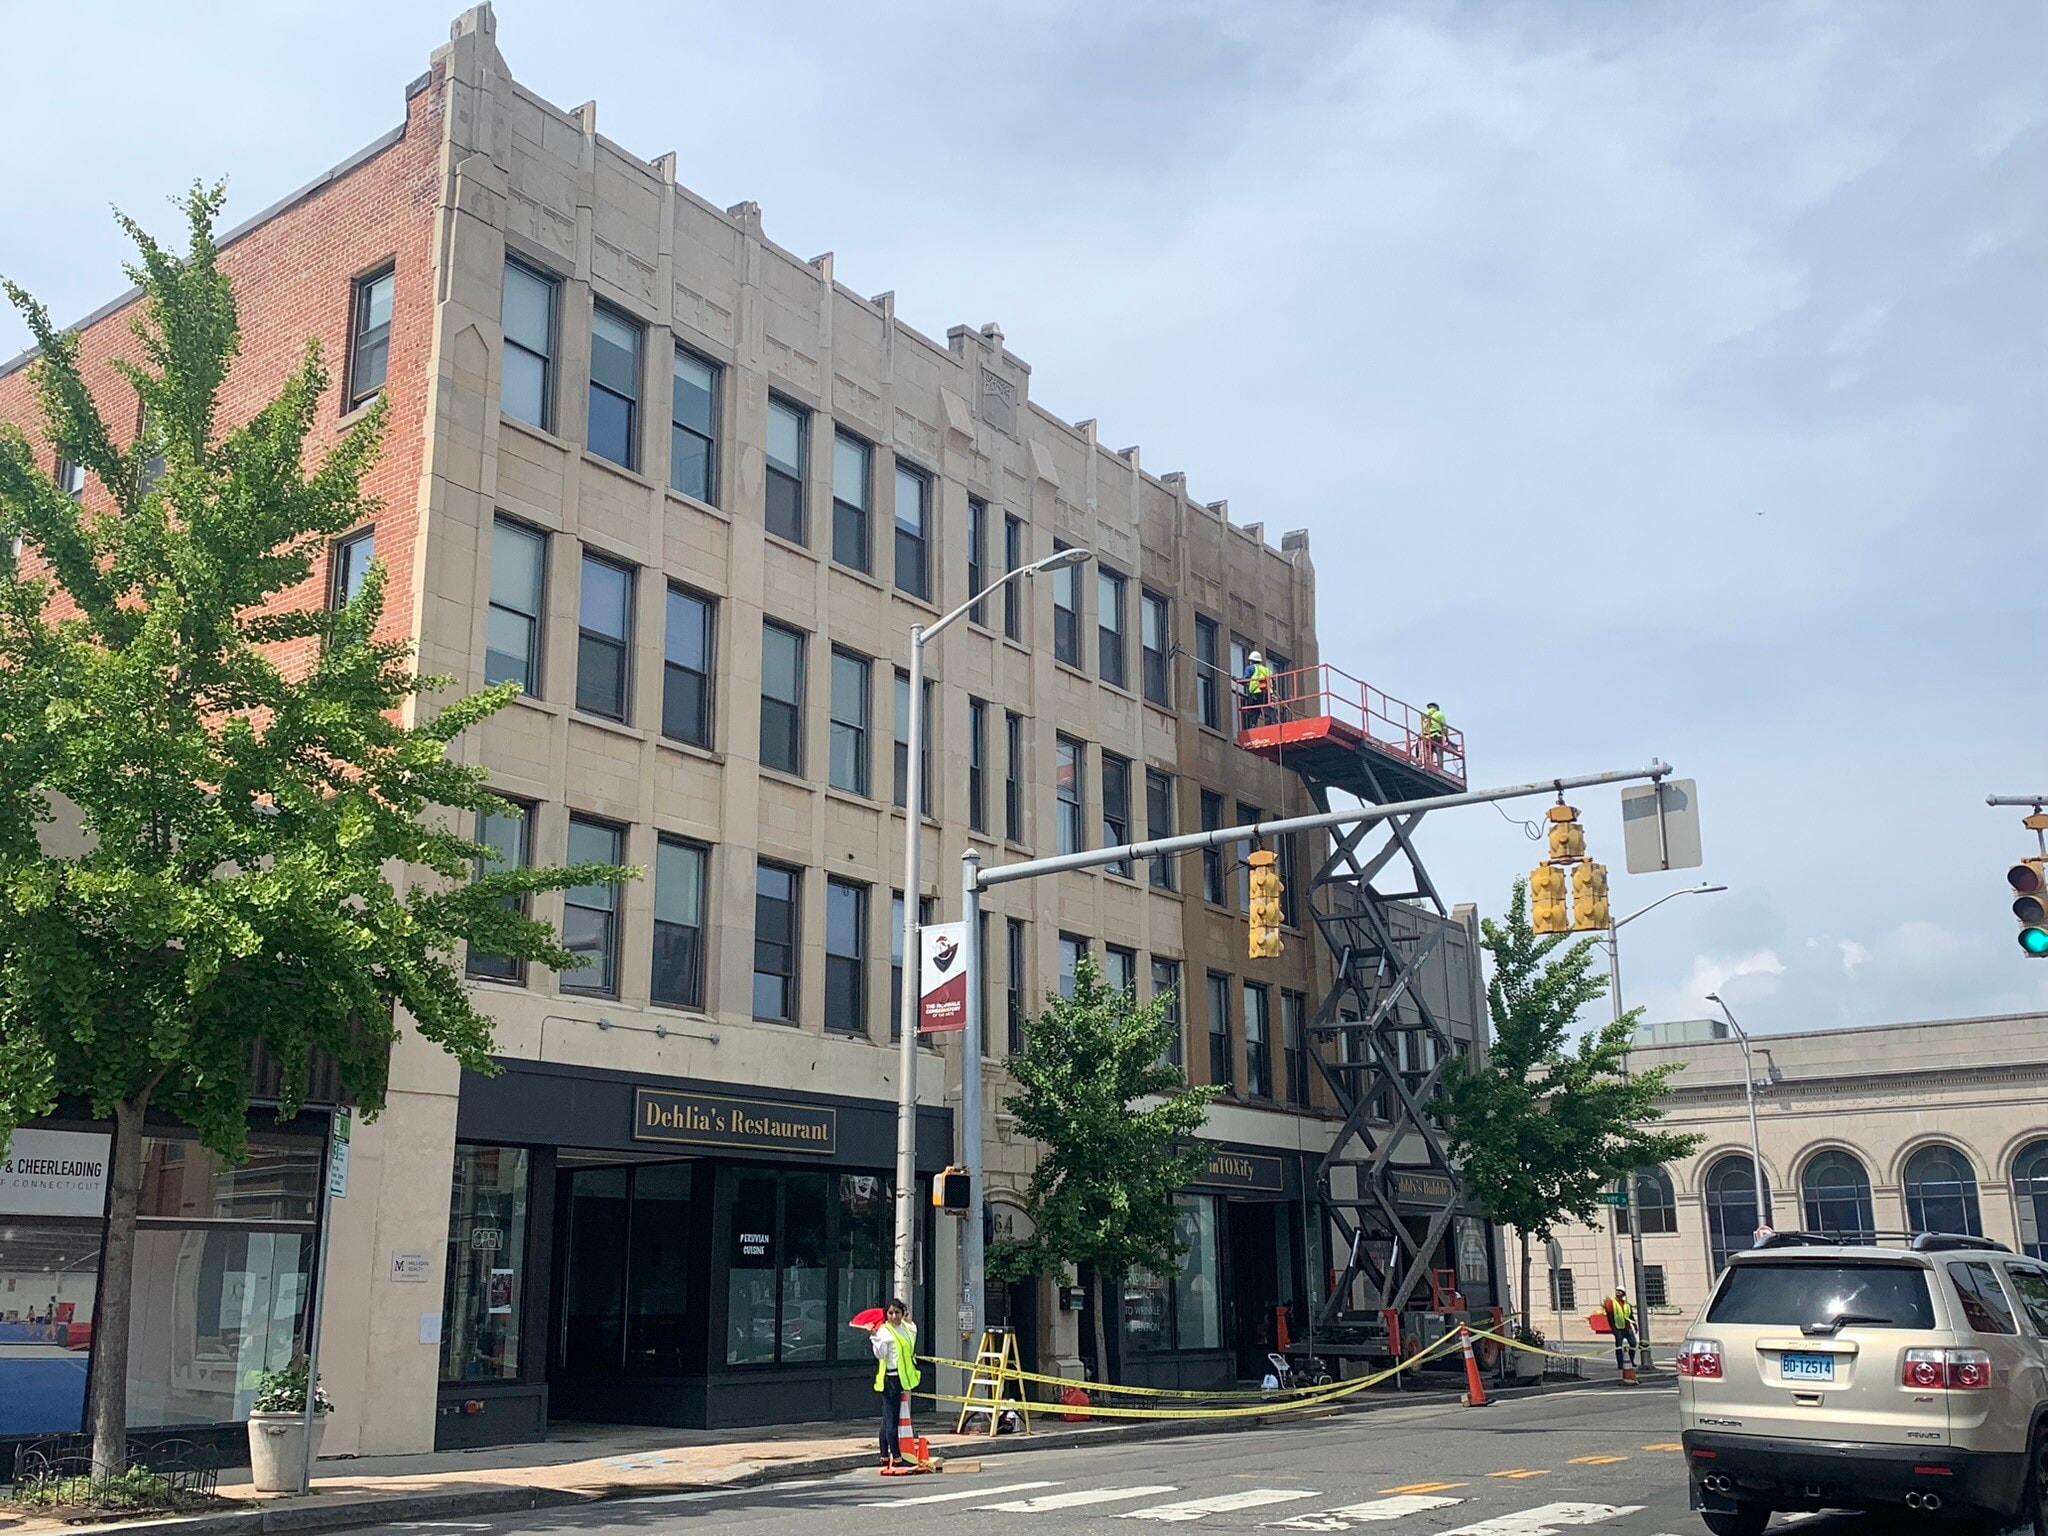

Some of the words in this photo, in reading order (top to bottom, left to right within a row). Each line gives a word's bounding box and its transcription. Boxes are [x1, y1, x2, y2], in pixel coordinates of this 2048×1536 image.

[646, 1102, 725, 1132] Dehlia's
[731, 1109, 829, 1141] Restaurant
[5, 1159, 13, 1173] &
[17, 1158, 102, 1177] CHEERLEADING
[13, 1179, 100, 1190] CONNECTICUT
[474, 1231, 501, 1247] OPEN
[739, 1233, 770, 1243] PERUVIAN
[743, 1245, 765, 1255] CUISINE
[1125, 1305, 1133, 1315] TO
